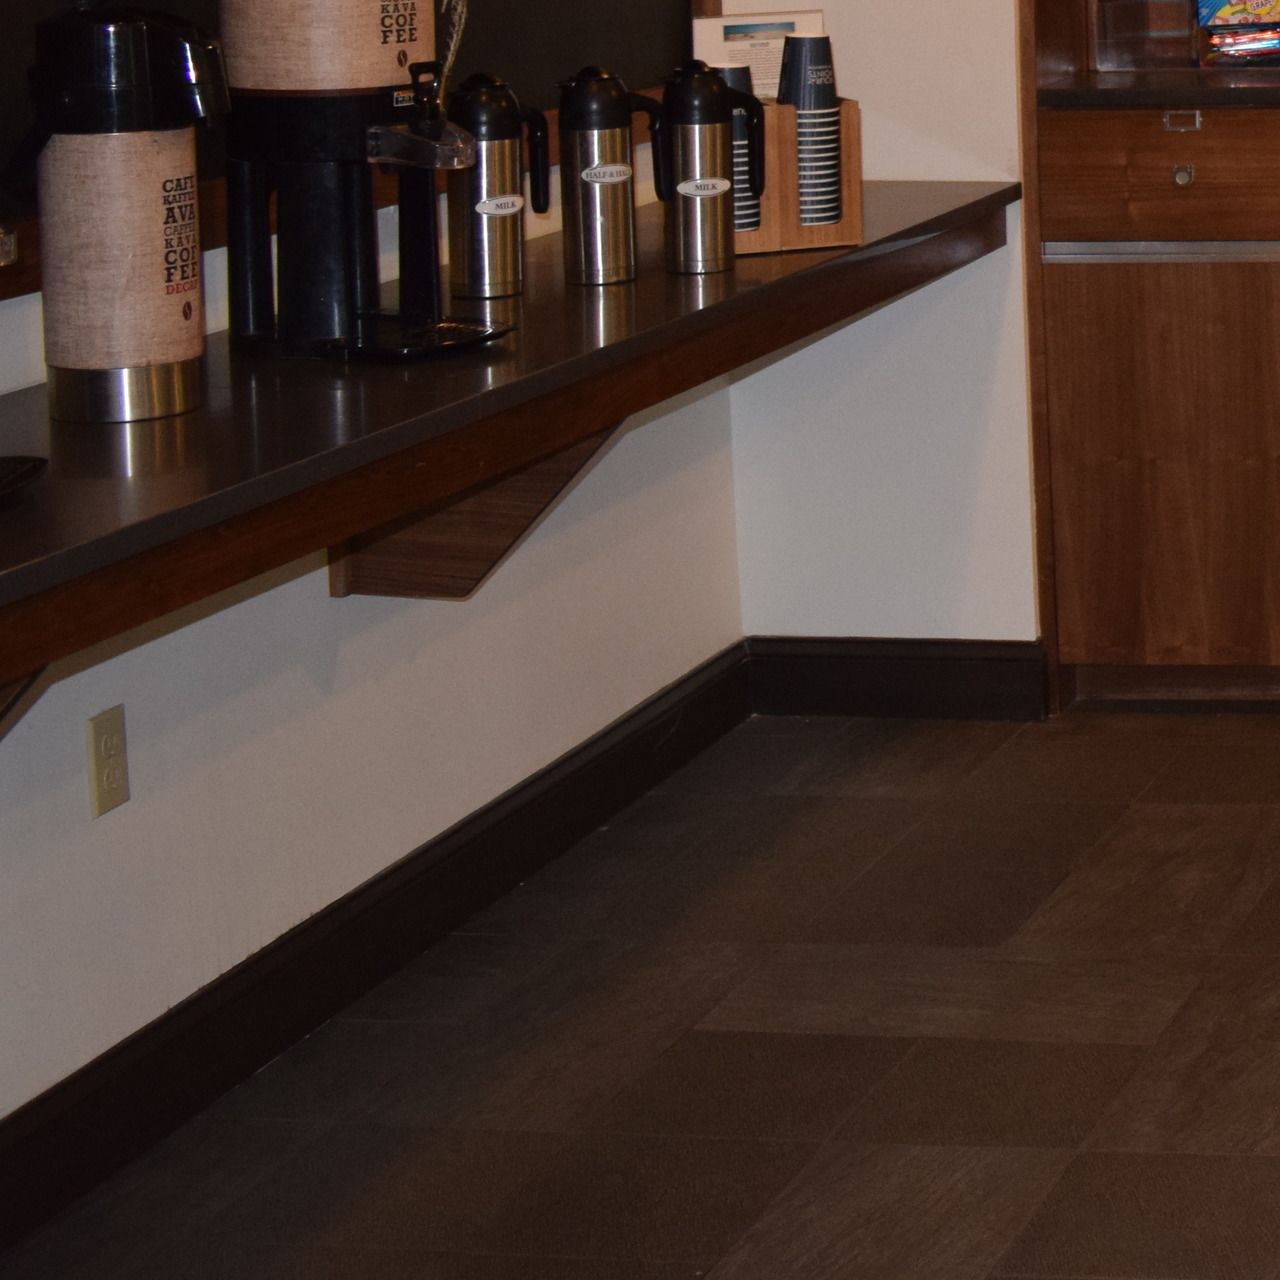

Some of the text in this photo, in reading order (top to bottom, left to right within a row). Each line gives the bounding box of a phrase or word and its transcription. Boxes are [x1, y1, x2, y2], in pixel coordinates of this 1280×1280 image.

[380, 2, 417, 14] KAVA
[380, 13, 417, 29] COF
[381, 28, 418, 45] FEE
[694, 183, 718, 193] MILK
[494, 200, 517, 211] MILK
[163, 204, 196, 225] AVA
